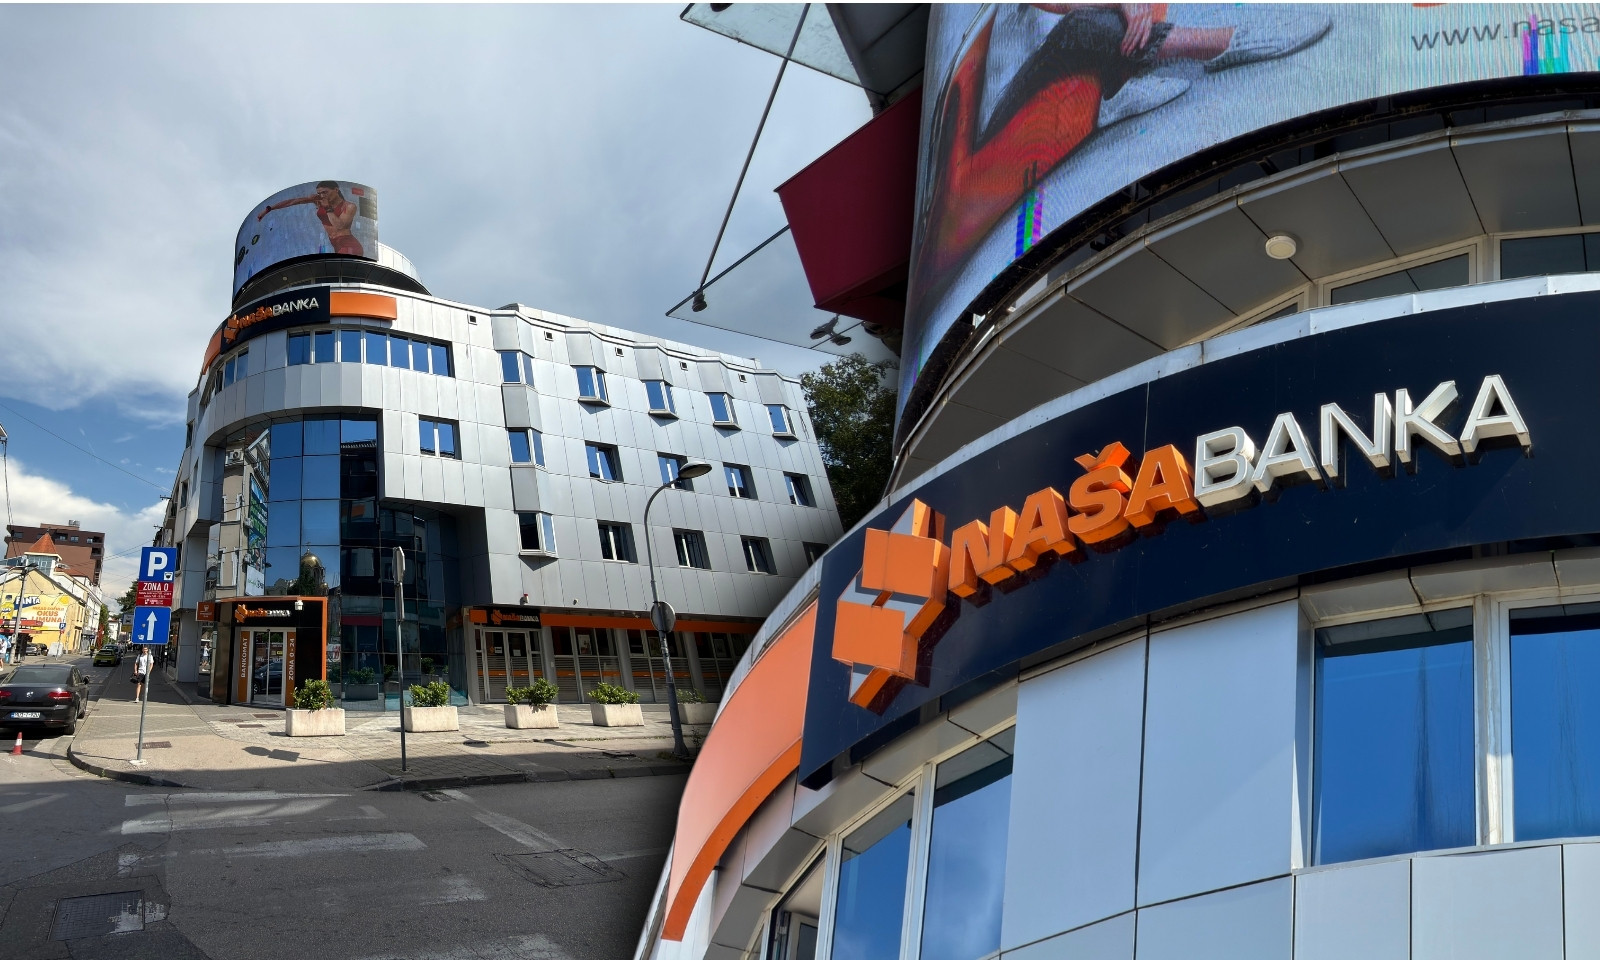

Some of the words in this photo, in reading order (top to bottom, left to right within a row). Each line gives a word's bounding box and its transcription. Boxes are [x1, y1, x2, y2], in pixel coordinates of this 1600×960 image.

[147, 551, 168, 576] P
[143, 582, 161, 591] ZONA
[289, 638, 295, 647] 24
